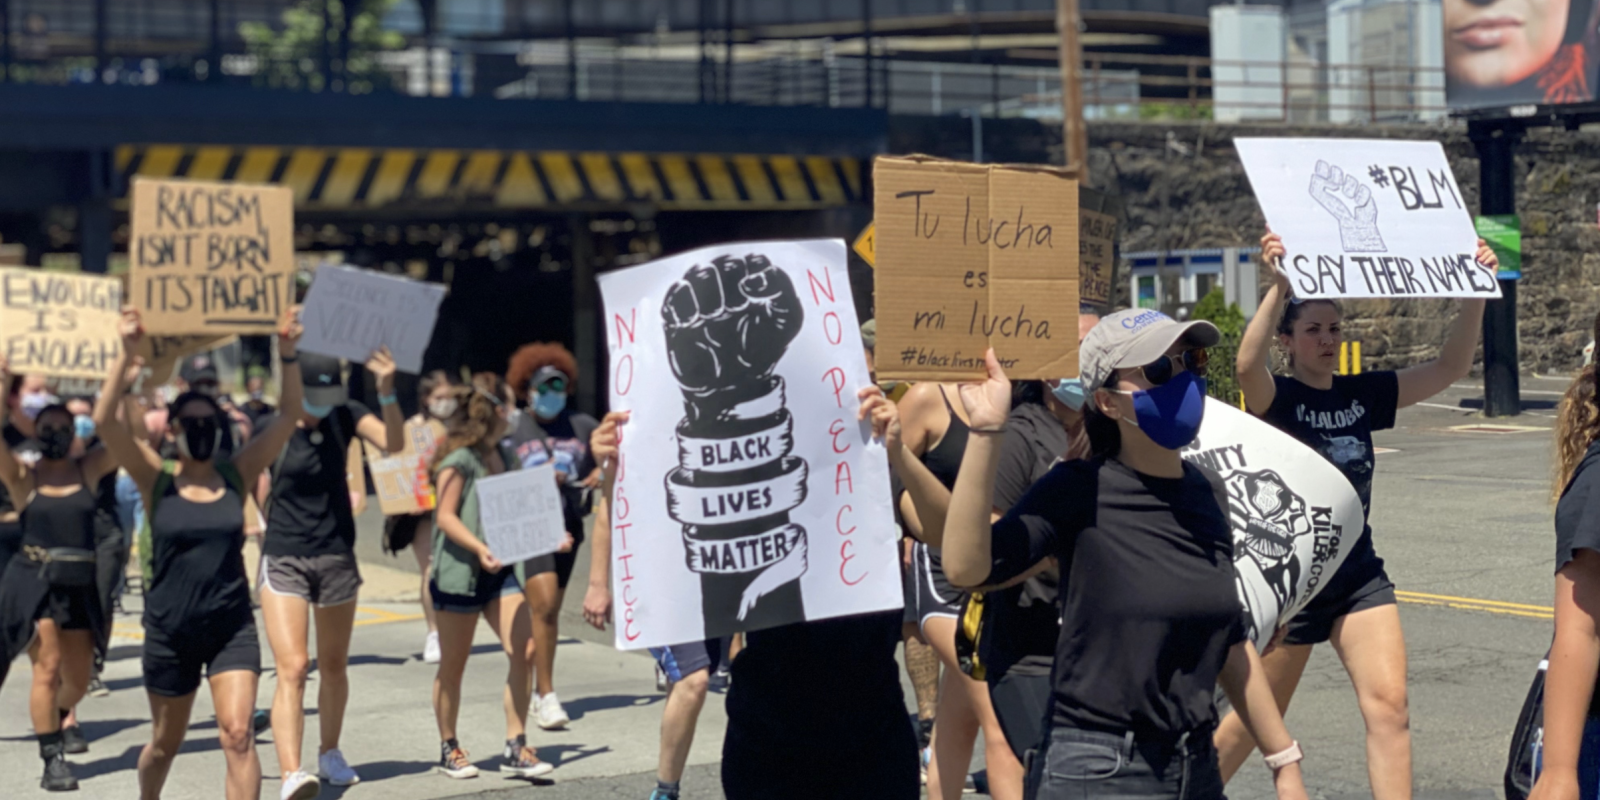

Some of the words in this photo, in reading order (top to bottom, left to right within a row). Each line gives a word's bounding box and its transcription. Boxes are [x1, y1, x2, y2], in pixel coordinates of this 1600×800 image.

[1367, 164, 1462, 210] #BLM
[895, 189, 940, 239] Tu
[962, 196, 1053, 249] lucha
[206, 230, 270, 272] BORN
[3, 273, 122, 313] ENOUGH
[963, 270, 988, 288] es
[1293, 254, 1346, 294] SAY
[1351, 255, 1426, 294] THEIR
[1420, 254, 1496, 293] NAMES
[27, 308, 78, 332] IS
[913, 306, 946, 330] mi
[969, 300, 1051, 339] lucha
[7, 335, 119, 371] ENOUGH
[901, 346, 1019, 369] #blacklivesmter
[701, 435, 772, 467] BLACK
[701, 487, 773, 518] LIVES
[701, 532, 788, 571] MATTER
[1311, 506, 1332, 564] KILLER
